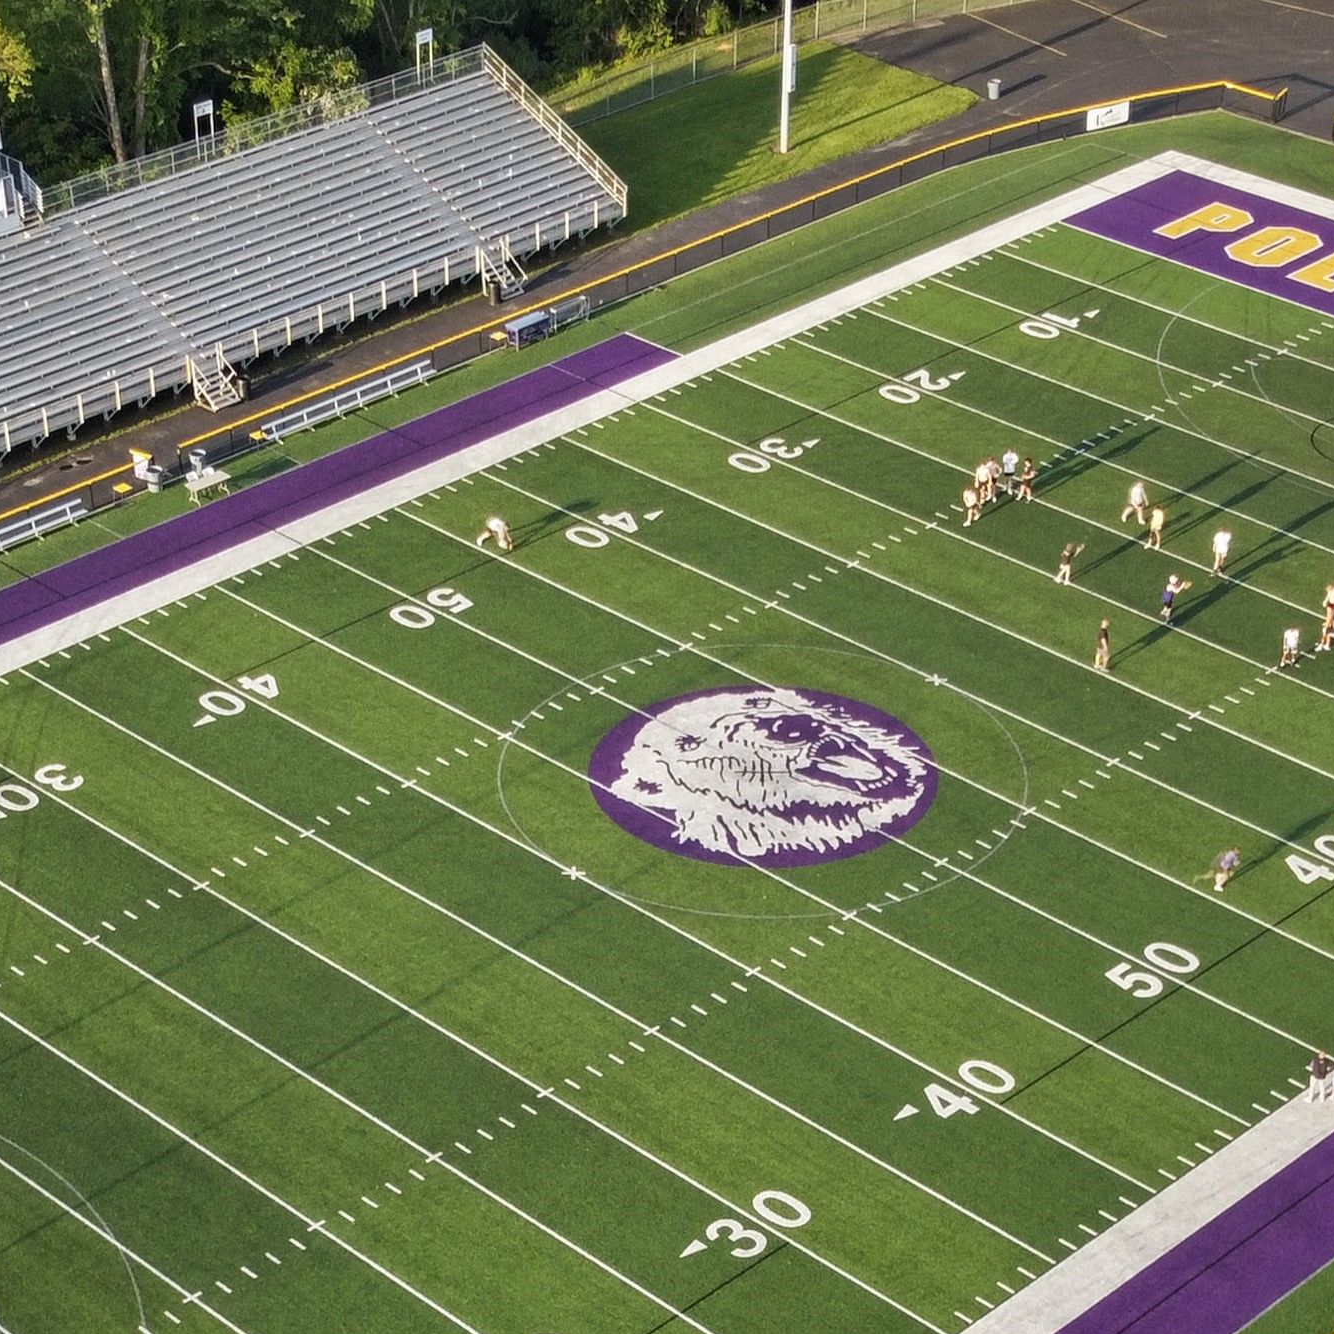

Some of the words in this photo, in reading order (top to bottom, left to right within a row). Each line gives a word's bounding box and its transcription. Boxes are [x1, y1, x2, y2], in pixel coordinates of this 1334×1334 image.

[1019, 312, 1081, 339] 10
[878, 369, 951, 404] 20
[727, 438, 804, 473] 30
[565, 511, 639, 548] 40
[389, 588, 474, 629] 50
[198, 674, 280, 716] 40
[1104, 942, 1200, 998] 50
[923, 1060, 1016, 1119] 40
[706, 1190, 812, 1258] 30
